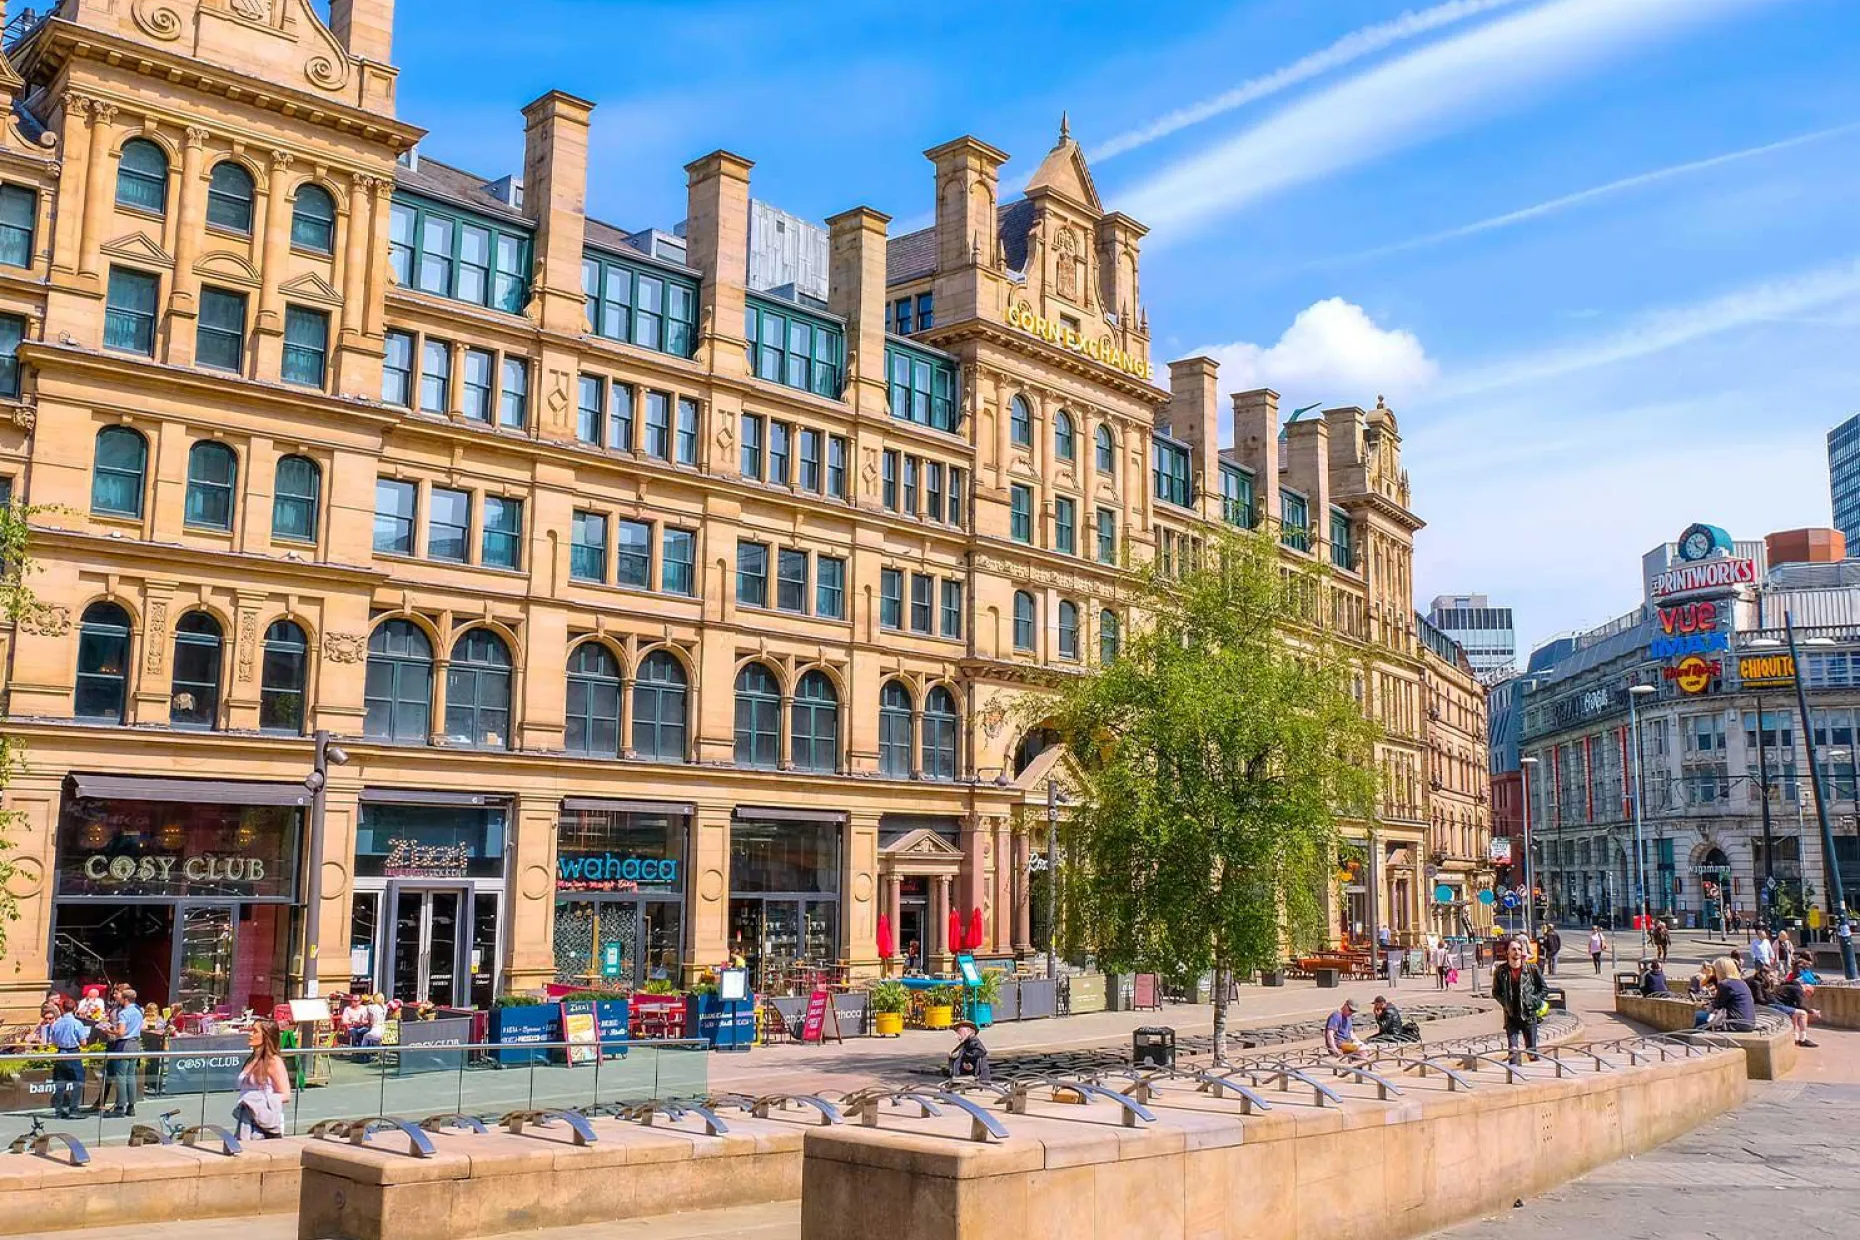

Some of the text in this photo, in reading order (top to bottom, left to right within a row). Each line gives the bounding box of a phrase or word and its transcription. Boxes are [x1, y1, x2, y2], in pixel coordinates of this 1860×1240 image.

[1005, 305, 1154, 379] CORN EXCHANGE
[1657, 561, 1752, 595] PRINTWORKS
[84, 854, 265, 881] COSY CLUB
[559, 852, 677, 880] wahaca
[835, 1010, 862, 1020] ahaca
[209, 1056, 240, 1067] CLUB
[30, 1081, 74, 1094] banyn
